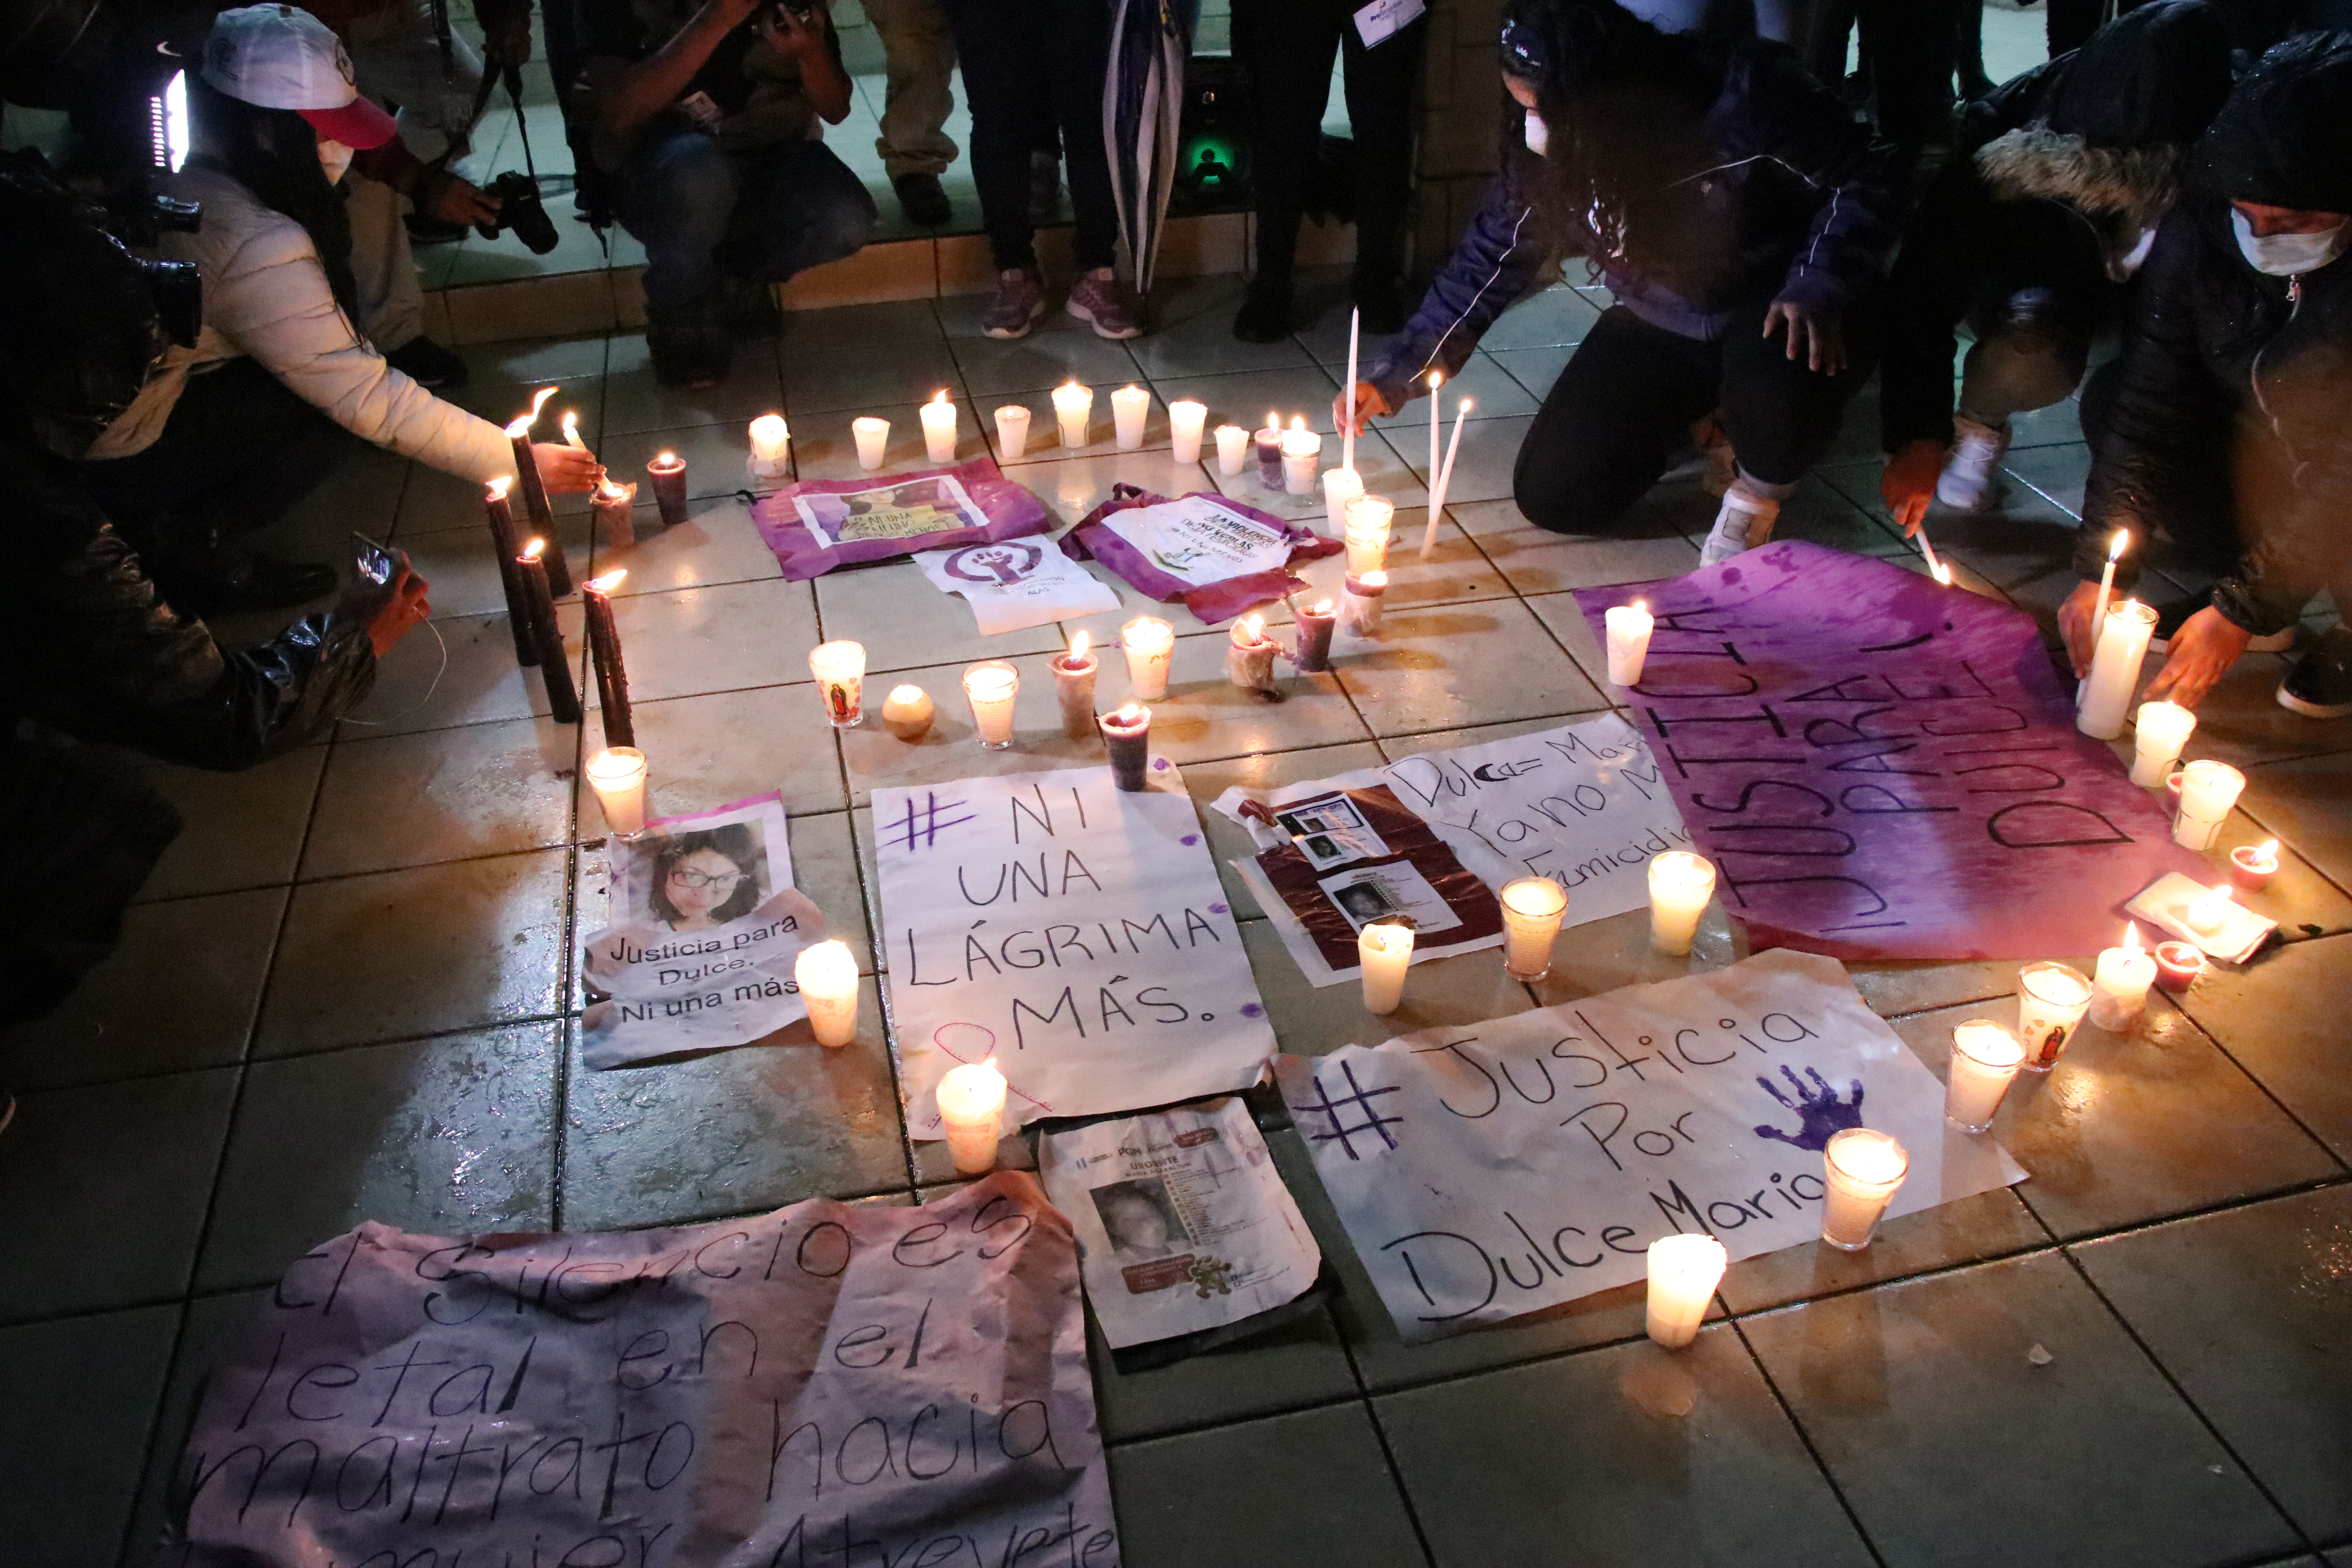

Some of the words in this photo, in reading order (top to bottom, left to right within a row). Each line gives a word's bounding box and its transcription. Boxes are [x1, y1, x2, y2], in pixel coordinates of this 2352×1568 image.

[886, 512, 912, 522] UNA
[1028, 587, 1050, 595] ALAS
[1784, 673, 1959, 815] PARA
[1012, 784, 1087, 844] NI
[1435, 809, 1539, 858] Ya
[958, 849, 1102, 906] UNA
[610, 937, 721, 964] Justicia
[733, 915, 799, 950] para
[908, 908, 1221, 986] LÁGRIMA
[622, 1002, 653, 1023] Ni
[666, 991, 722, 1017] una
[735, 977, 800, 1002] más
[659, 958, 754, 987] Dulce.
[1013, 975, 1215, 1050] MÁS.
[1410, 1010, 1819, 1118] Justicia
[1130, 1156, 1179, 1170] URGENTE
[1560, 1102, 1695, 1171] Por
[892, 1196, 1032, 1267] es
[1381, 1211, 1650, 1322] Dulce
[234, 1332, 538, 1433] letal
[617, 1321, 759, 1390] en
[834, 1298, 933, 1369] el
[189, 1413, 695, 1529] maltrato
[767, 1393, 1065, 1502] hacia
